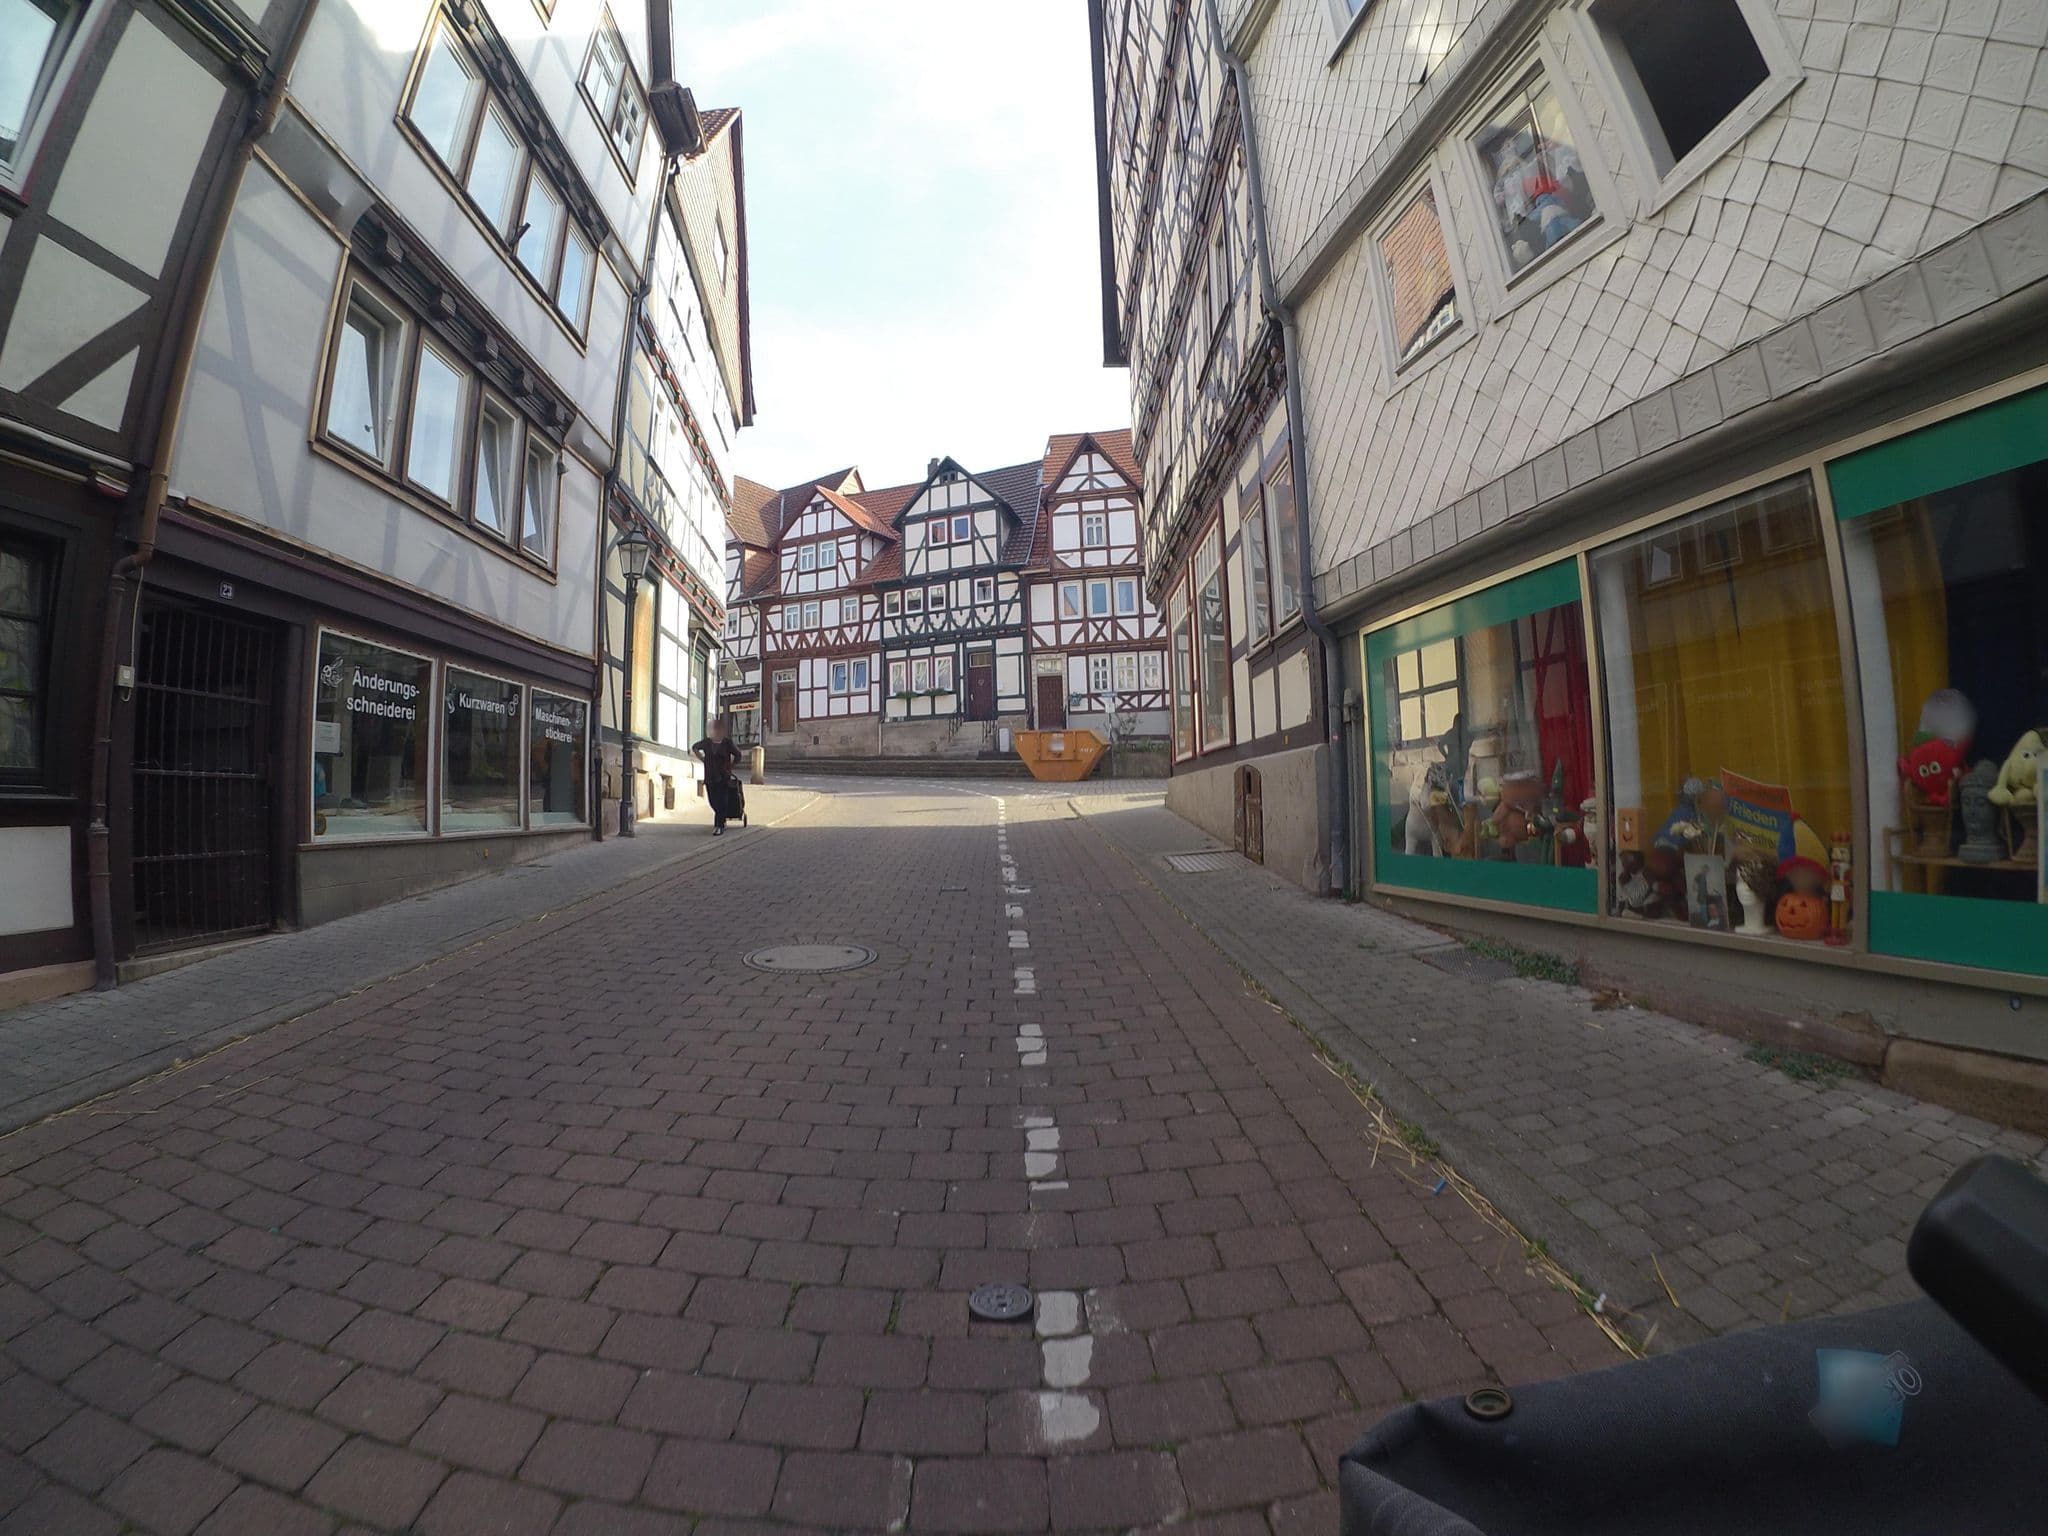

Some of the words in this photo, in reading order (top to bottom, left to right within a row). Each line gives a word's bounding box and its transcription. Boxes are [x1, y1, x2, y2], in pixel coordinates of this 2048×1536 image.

[222, 583, 233, 597] 23
[352, 664, 421, 700] Änderungs-
[346, 695, 416, 721] schneiderei
[459, 691, 505, 714] Kurzwaren
[545, 725, 573, 743] stickerei
[1733, 800, 1778, 827] Frieden
